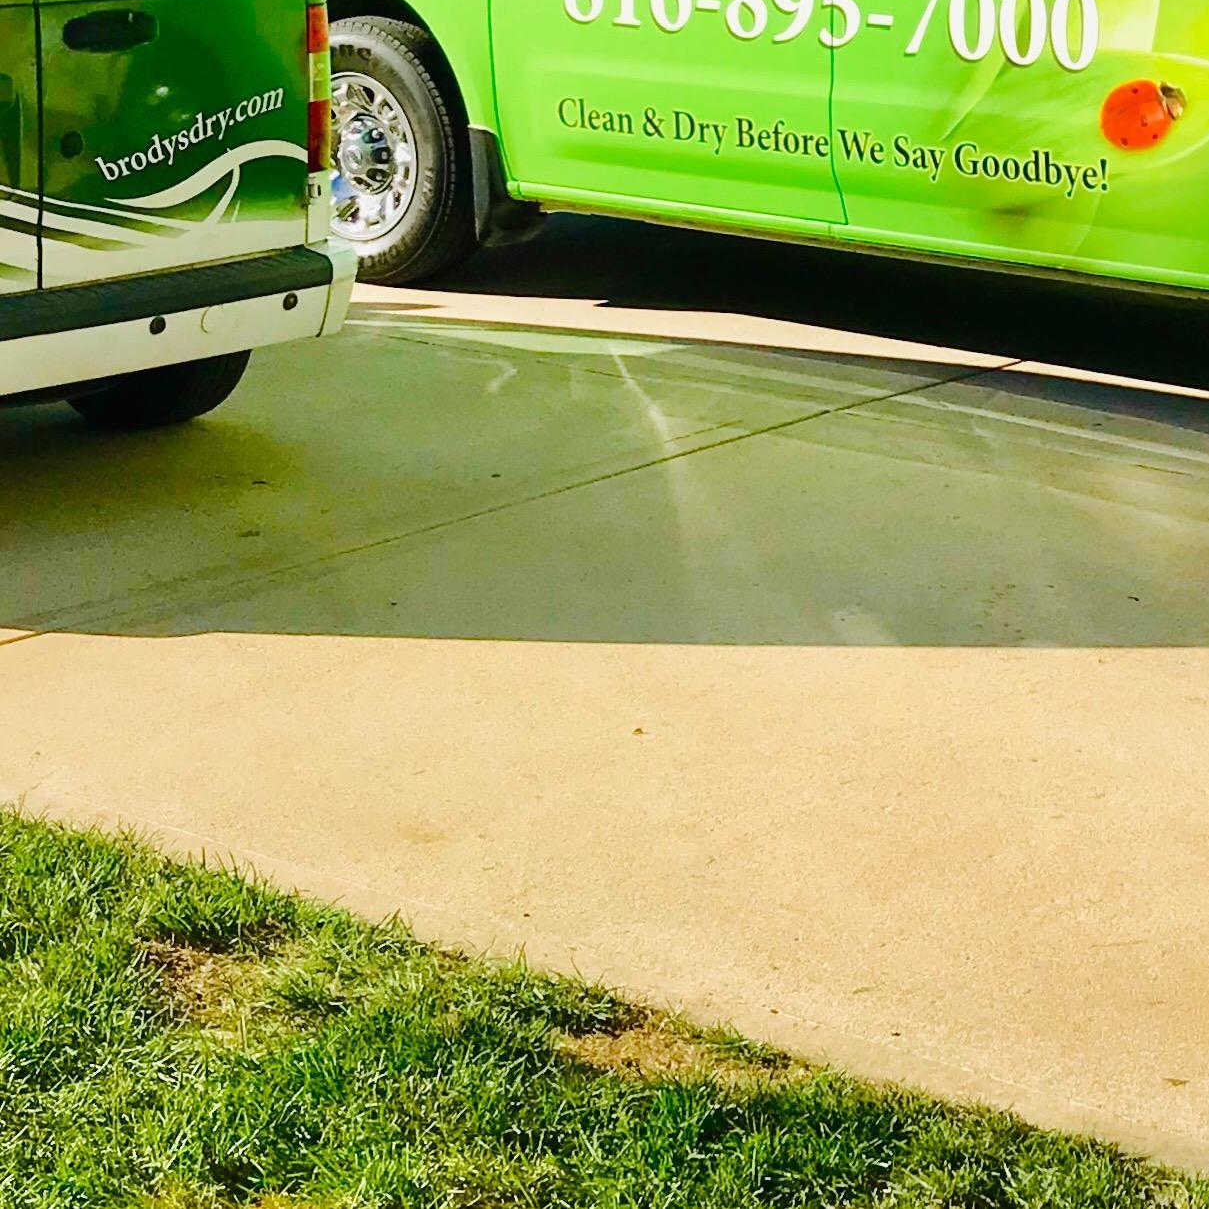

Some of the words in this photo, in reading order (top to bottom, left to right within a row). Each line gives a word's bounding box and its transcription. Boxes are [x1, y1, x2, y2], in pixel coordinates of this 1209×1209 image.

[95, 87, 284, 181] brodysdry.com
[557, 97, 633, 135] Clean
[641, 107, 666, 138] &
[672, 110, 728, 156] Dry
[736, 118, 829, 158] Before
[838, 129, 886, 164] We
[894, 136, 947, 182] Say
[953, 143, 1109, 198] Goodbye!
